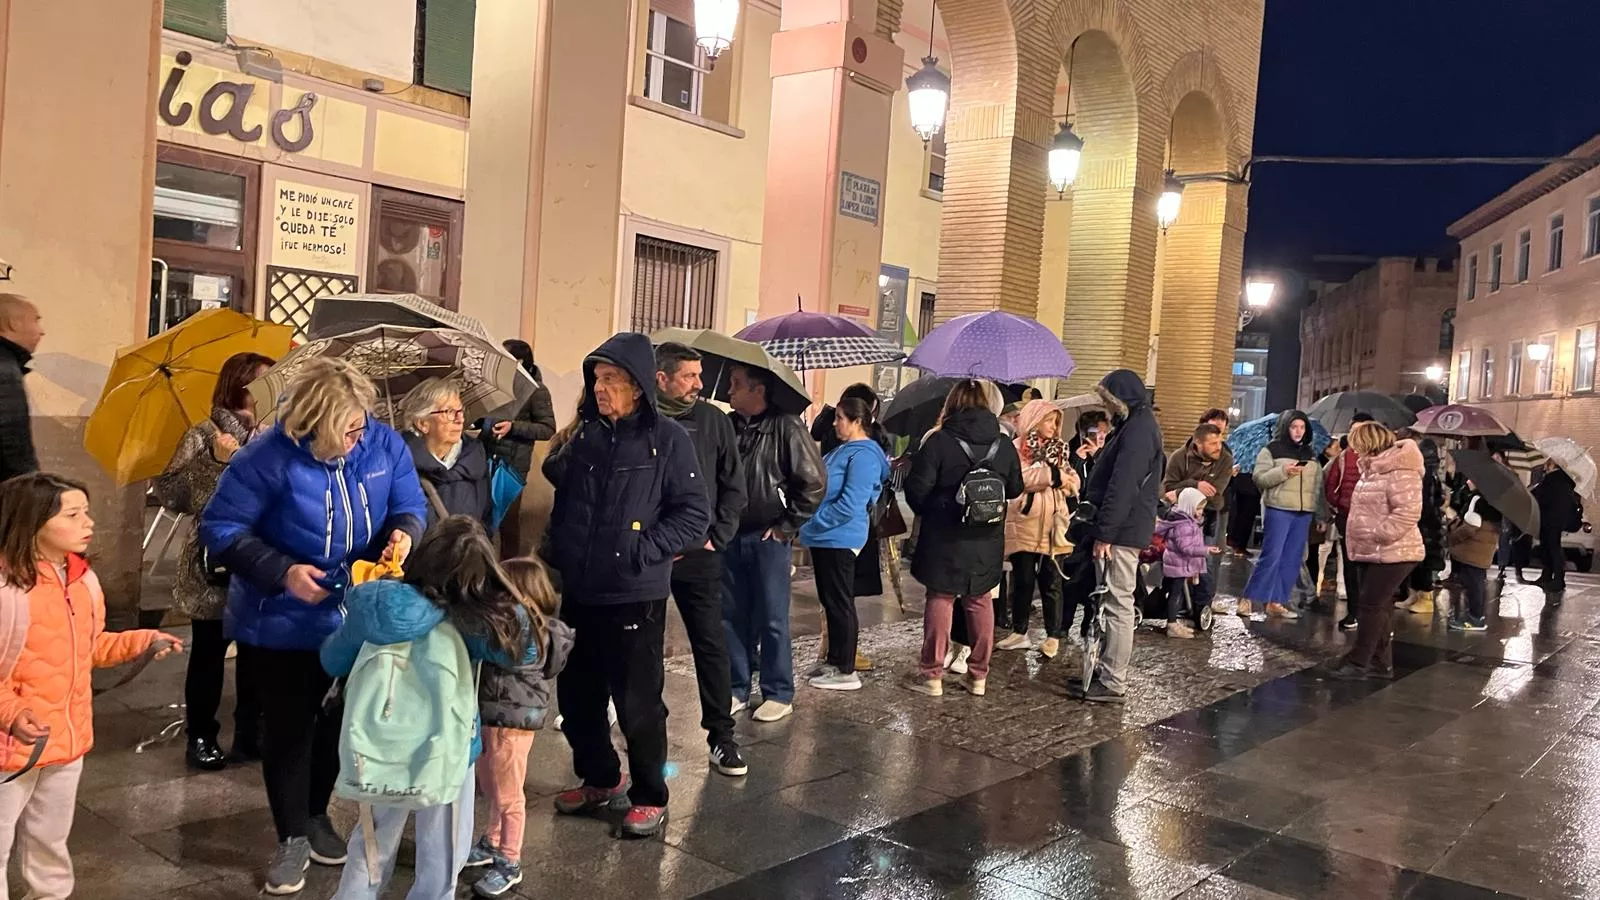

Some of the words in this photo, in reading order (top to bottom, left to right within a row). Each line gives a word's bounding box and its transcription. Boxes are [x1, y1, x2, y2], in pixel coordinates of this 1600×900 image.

[279, 188, 296, 202] ME
[298, 192, 318, 204] PIDIÓ
[321, 196, 332, 206] UN
[332, 198, 354, 210] CAFÉ
[280, 204, 287, 216] Y
[291, 207, 301, 217] LE
[281, 237, 299, 250] ¡FUE
[302, 241, 346, 255] HERMOSO!
